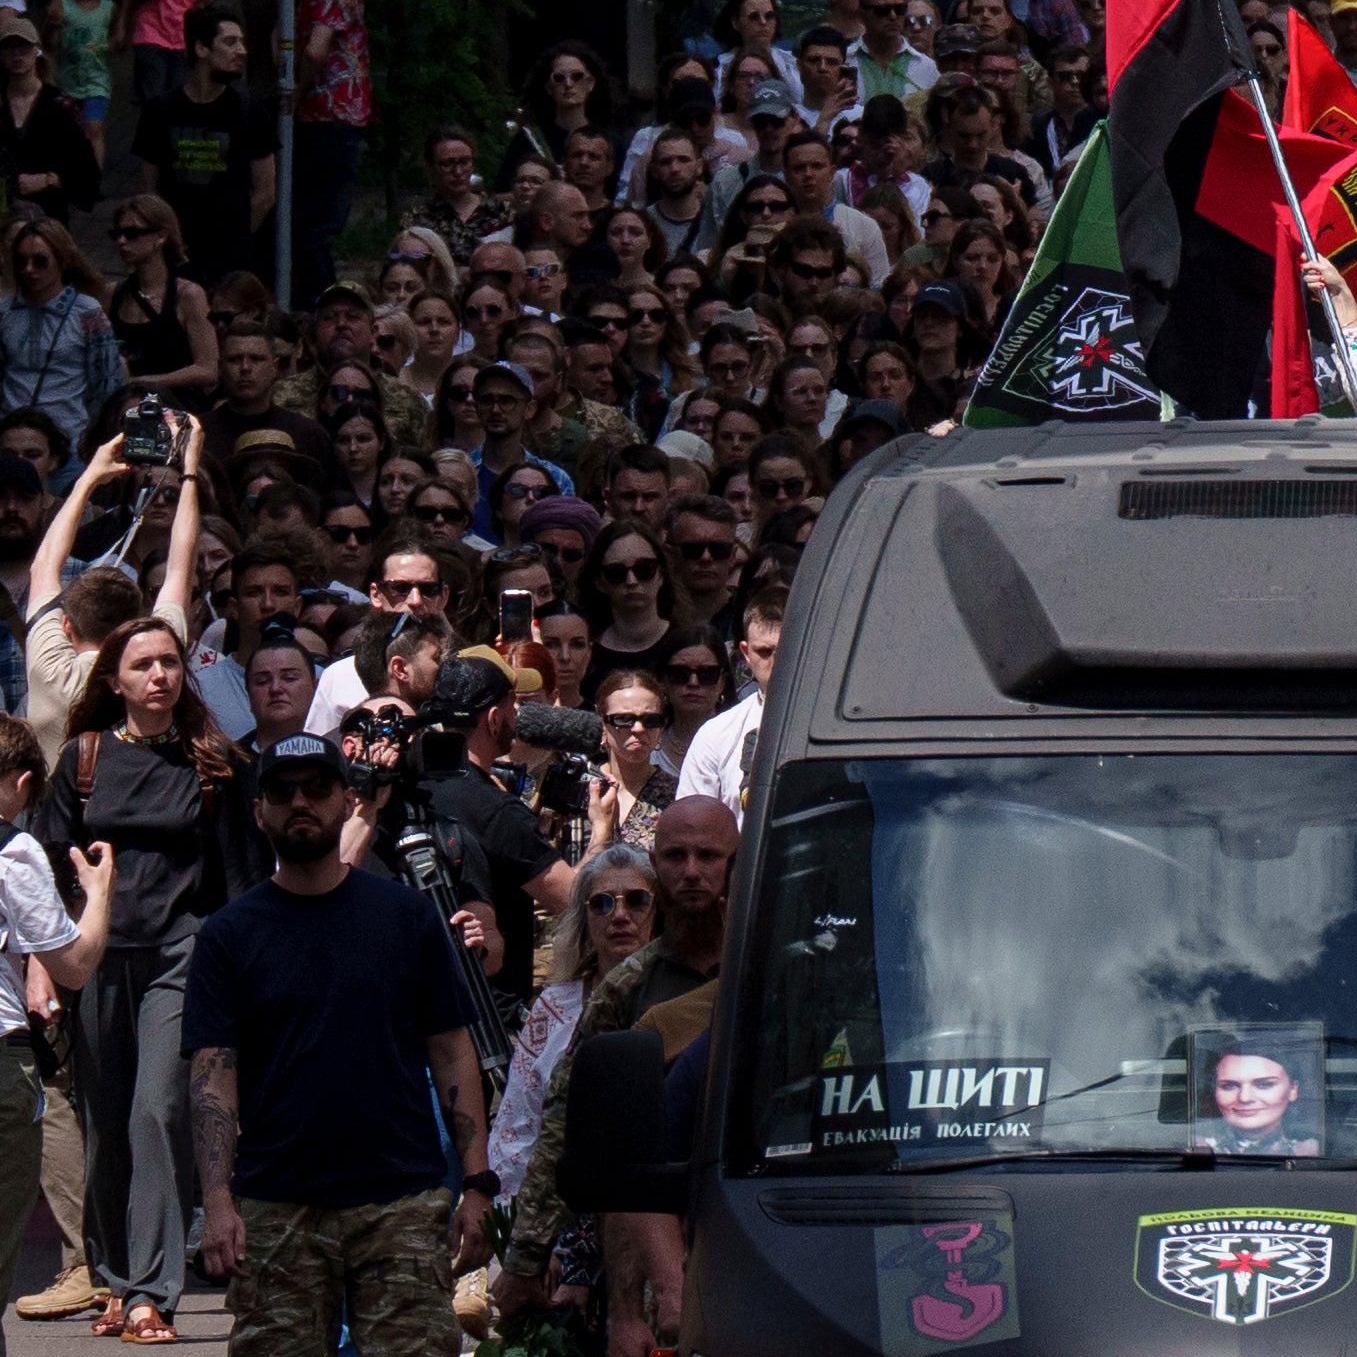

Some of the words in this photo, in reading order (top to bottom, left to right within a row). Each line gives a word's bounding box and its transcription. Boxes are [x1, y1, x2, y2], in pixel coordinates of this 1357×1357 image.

[279, 738, 323, 754] YAMAHA
[820, 1073, 885, 1116] НА
[908, 1066, 1045, 1111] ЩИТІ
[936, 1121, 1031, 1138] ПОЛЕГЛИХ
[1150, 1209, 1239, 1222] ПОЛЬОВА
[1246, 1209, 1347, 1222] МЕДИЦИНА
